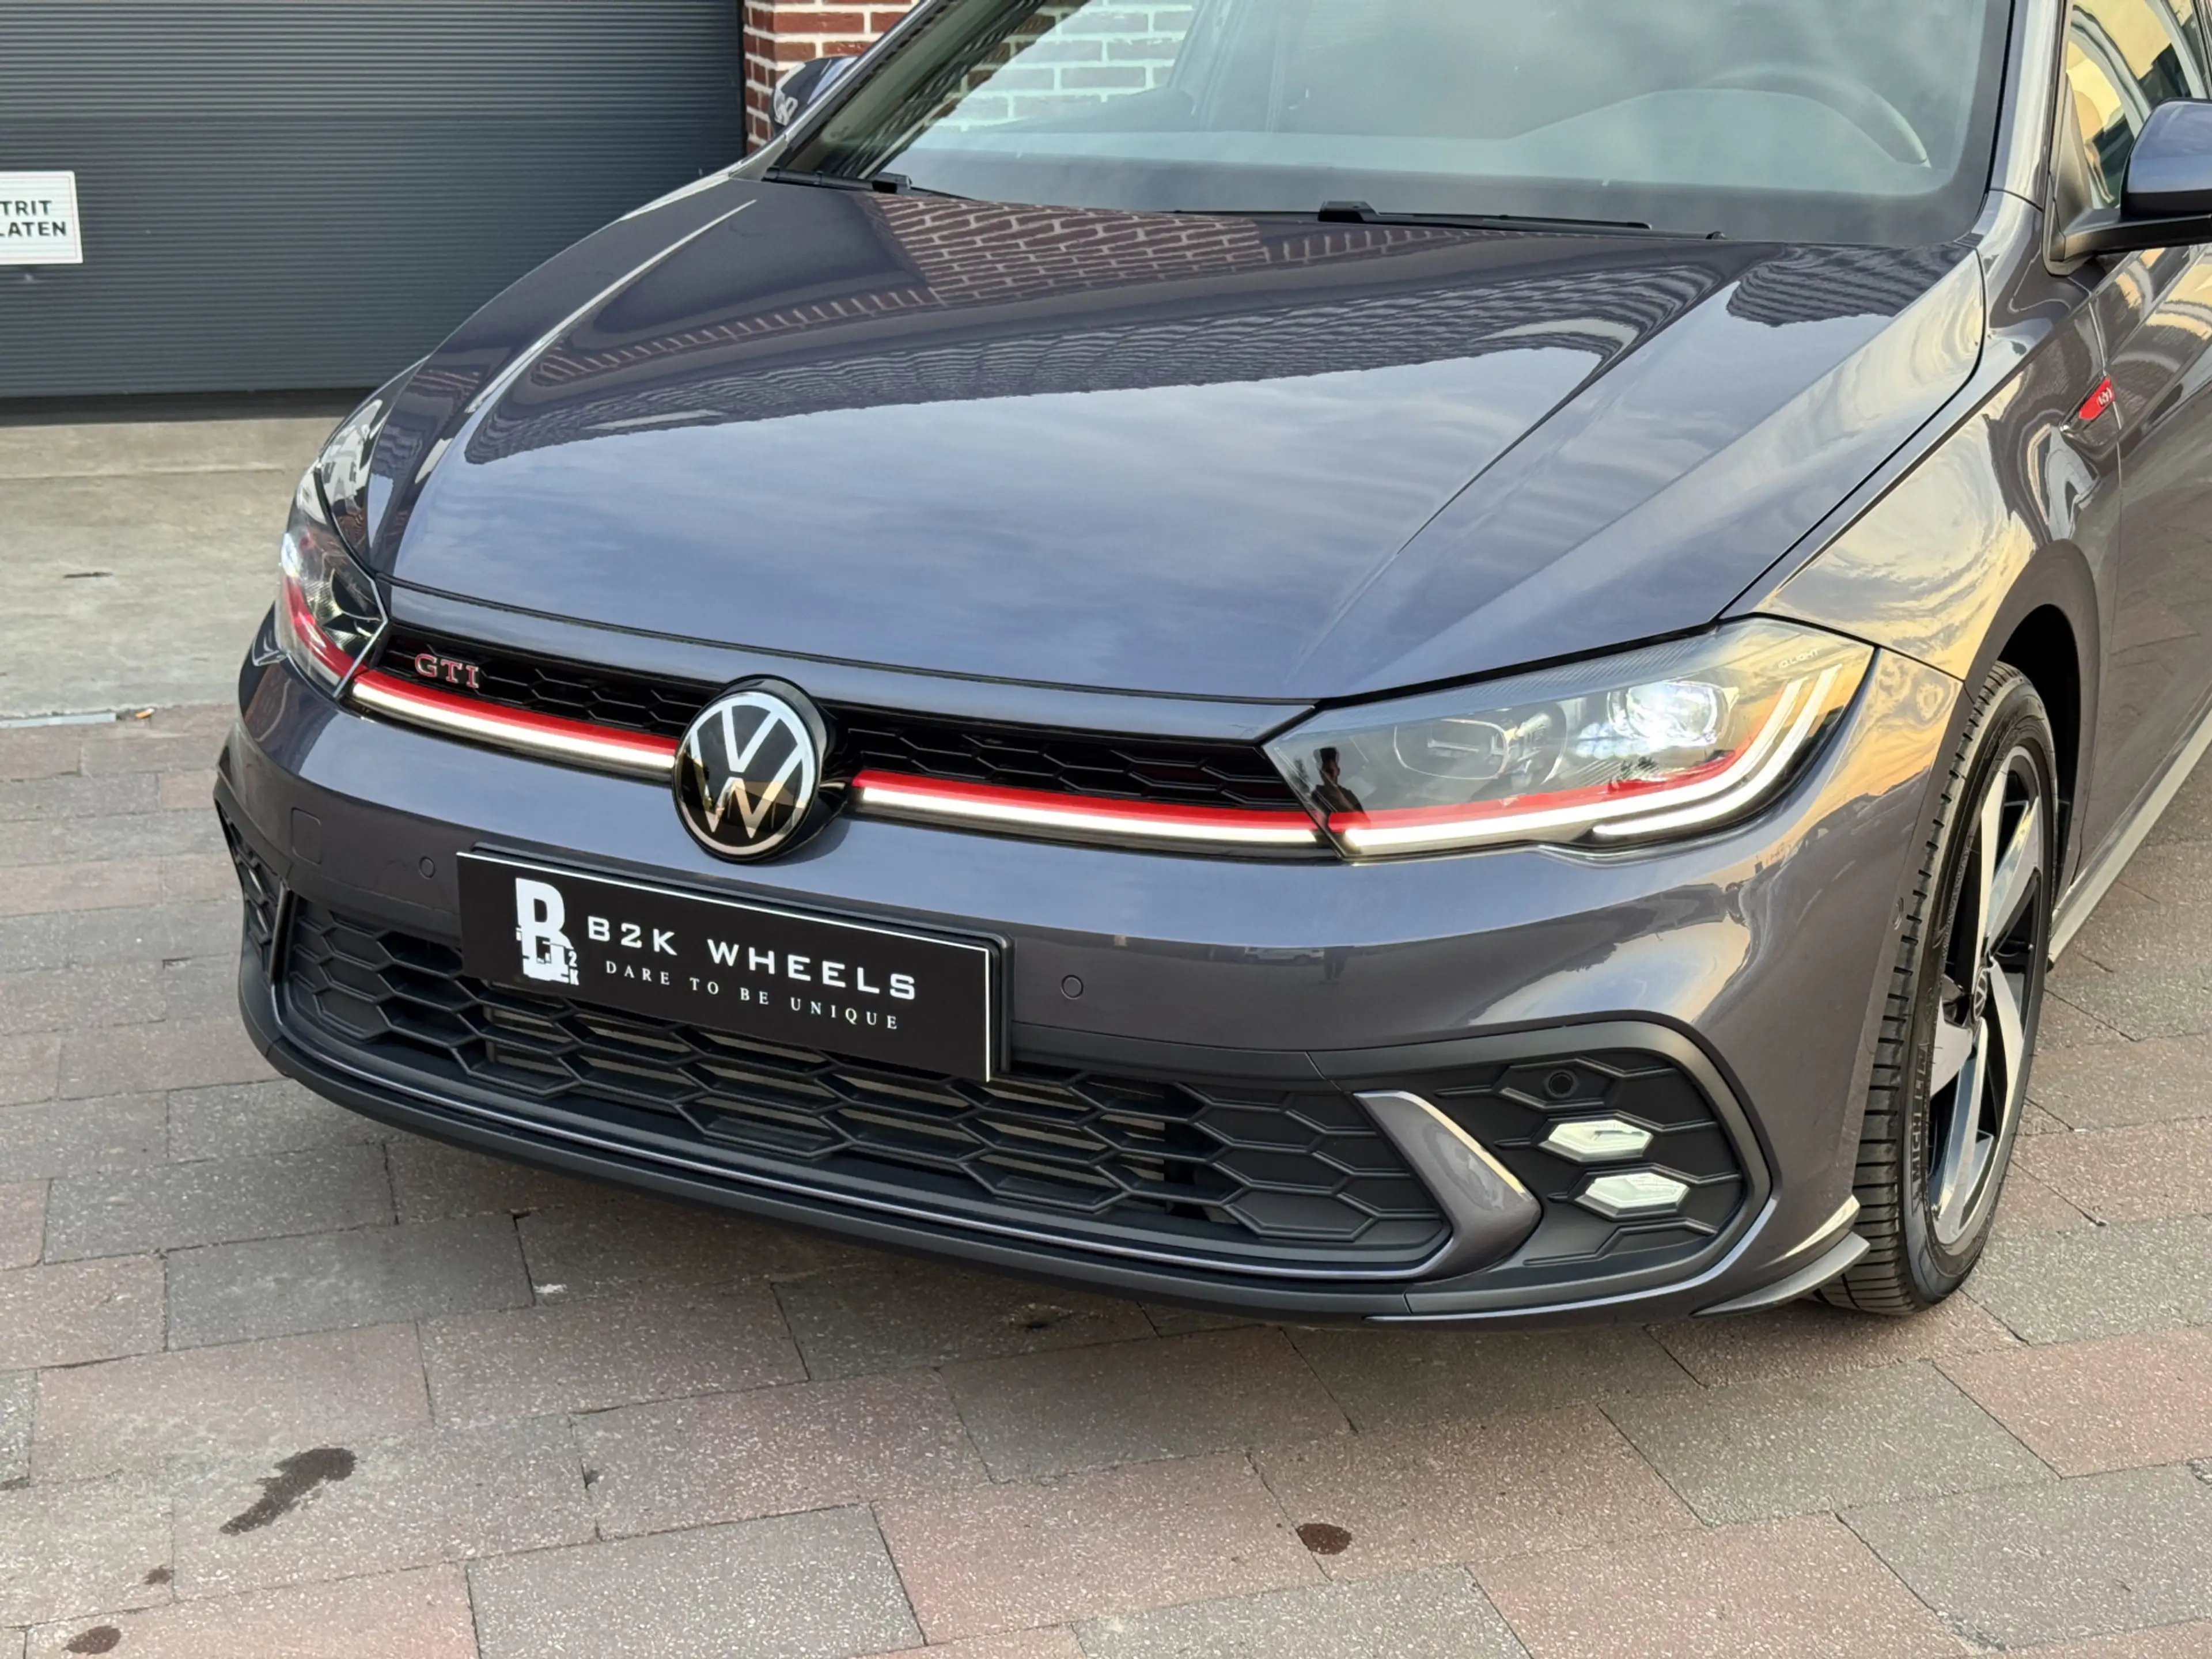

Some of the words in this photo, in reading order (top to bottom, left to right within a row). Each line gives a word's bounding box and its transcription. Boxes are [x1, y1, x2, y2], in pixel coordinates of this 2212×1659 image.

[415, 653, 479, 688] GTI
[588, 915, 678, 956] B2K
[707, 938, 915, 1000] WHEELS
[605, 960, 670, 986] DARE
[690, 977, 719, 995] TO
[740, 987, 769, 1005] BE
[790, 997, 897, 1029] UNIQUE
